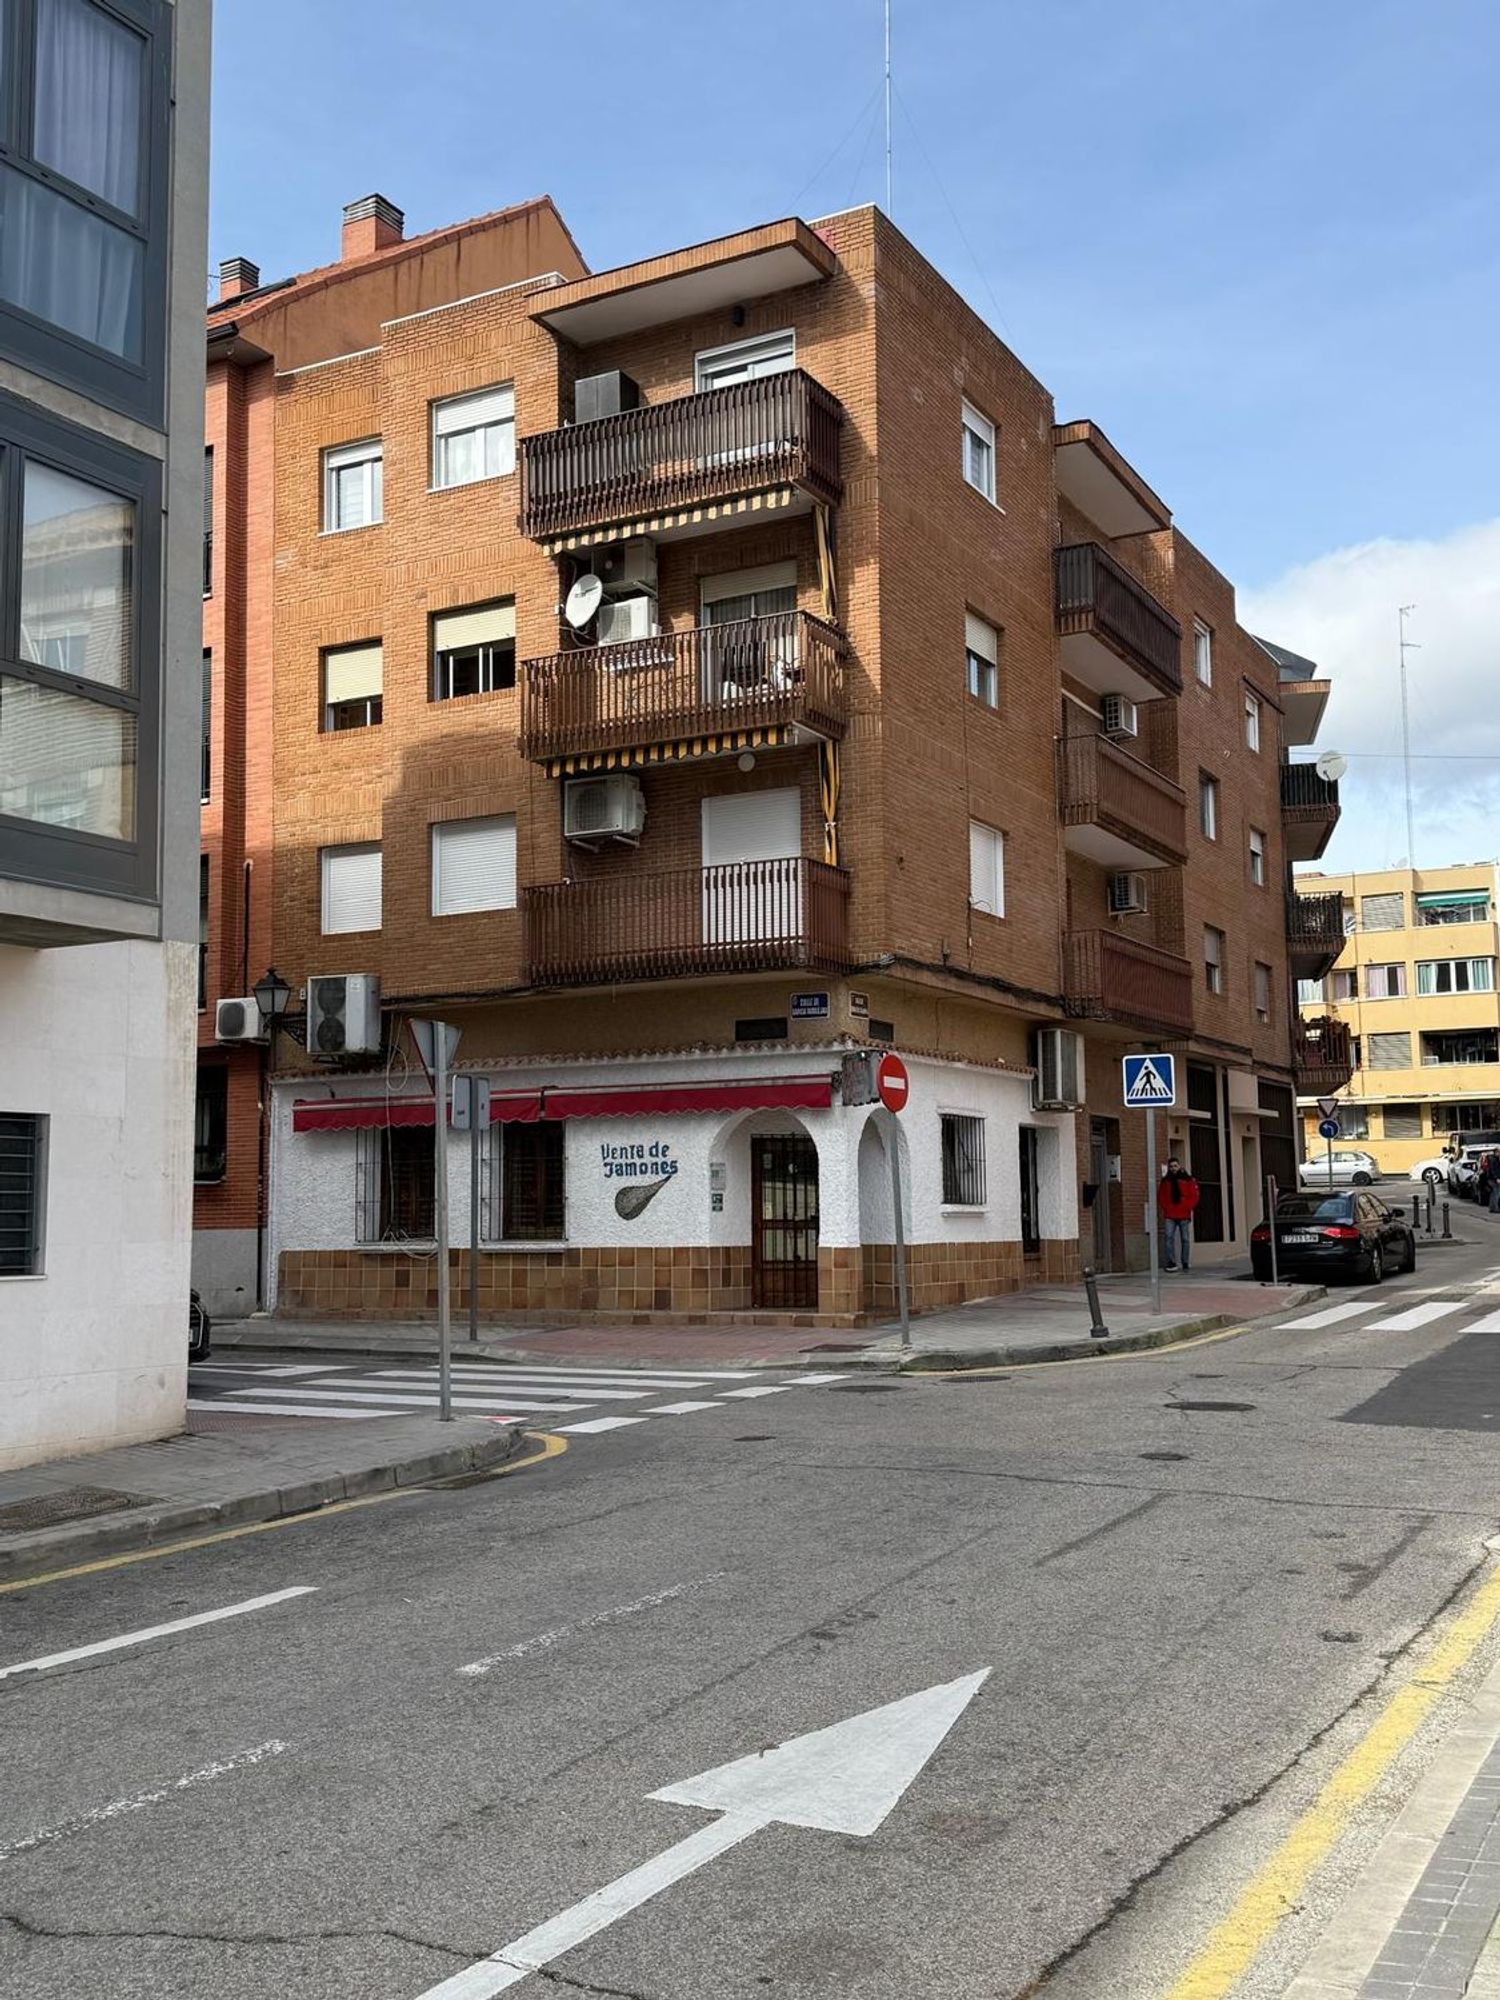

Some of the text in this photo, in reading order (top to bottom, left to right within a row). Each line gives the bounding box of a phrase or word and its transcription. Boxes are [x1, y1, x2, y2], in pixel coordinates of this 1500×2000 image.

[601, 1141, 670, 1161] Venta de
[603, 1160, 678, 1178] Jamones
